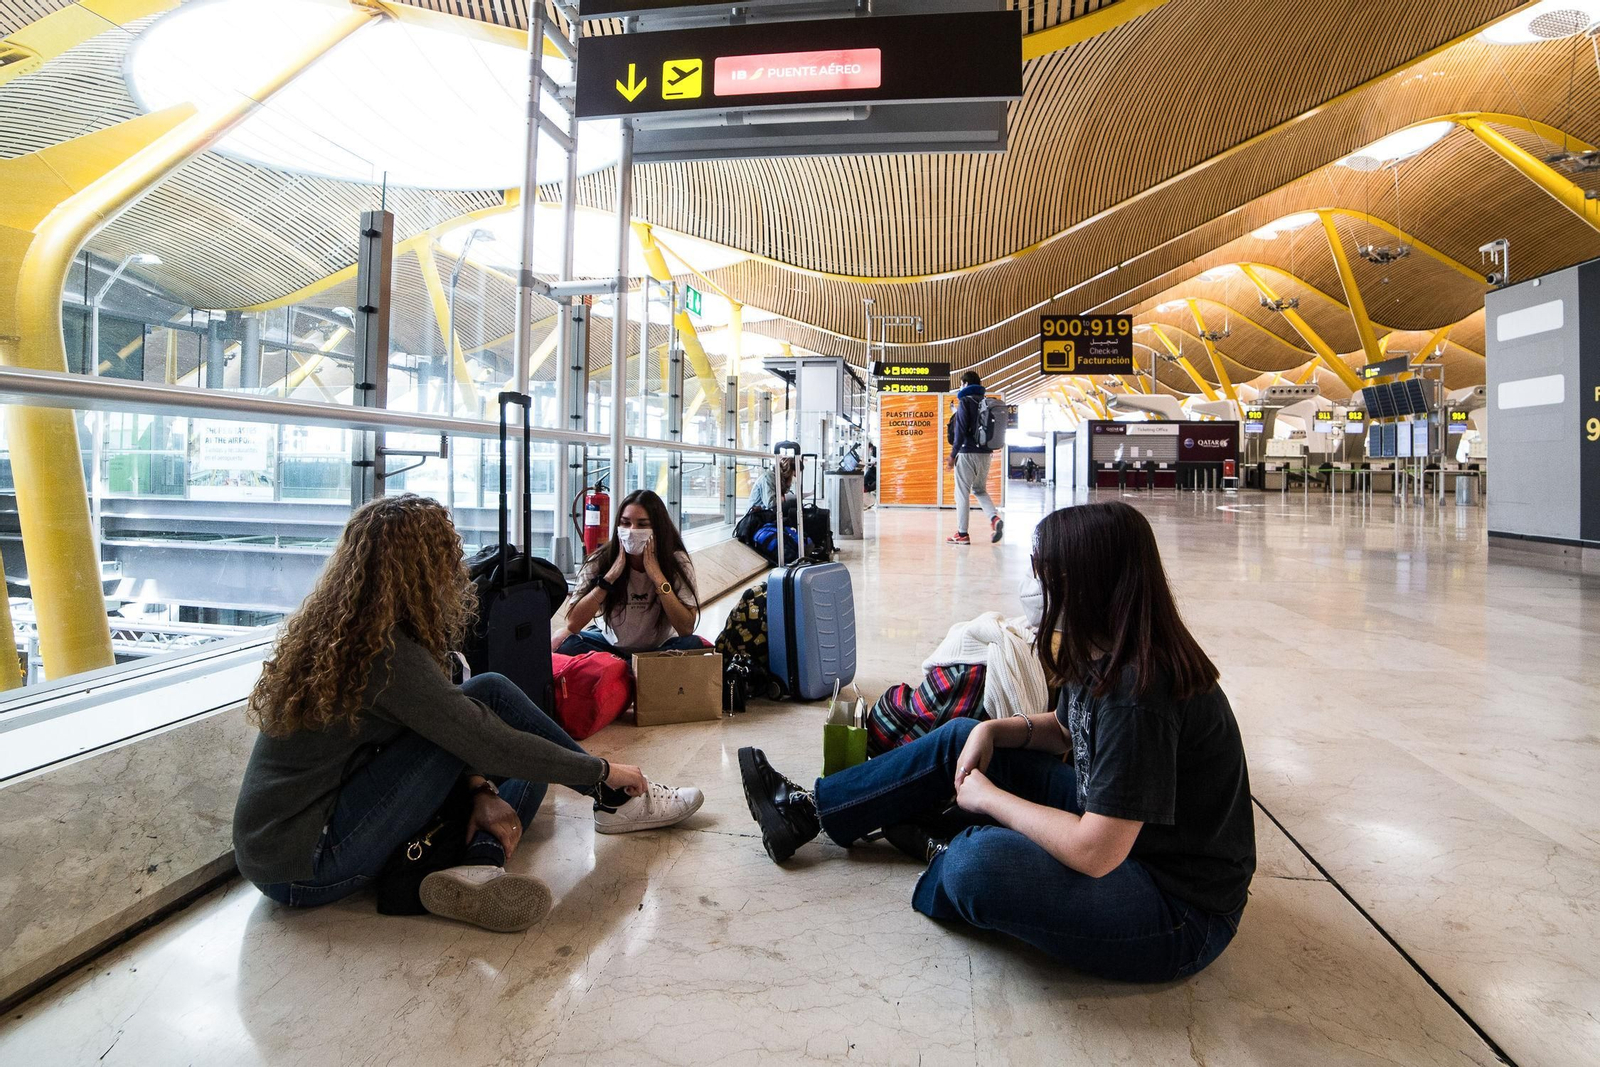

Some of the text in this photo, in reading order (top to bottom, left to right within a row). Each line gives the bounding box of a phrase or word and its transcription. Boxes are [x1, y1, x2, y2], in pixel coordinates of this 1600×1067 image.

[731, 62, 861, 80] IB PUENTE AÉREO
[1042, 319, 1082, 337] 900
[1090, 318, 1130, 337] 919
[1089, 347, 1119, 355] Check-in
[1077, 356, 1130, 365] Facturación
[1248, 411, 1262, 419] 910
[1318, 412, 1331, 420] 911
[1348, 412, 1363, 420] 912
[1451, 412, 1466, 420] 914
[214, 436, 227, 444] THE
[227, 436, 256, 444] AIRPO
[1197, 439, 1220, 447] QATAR
